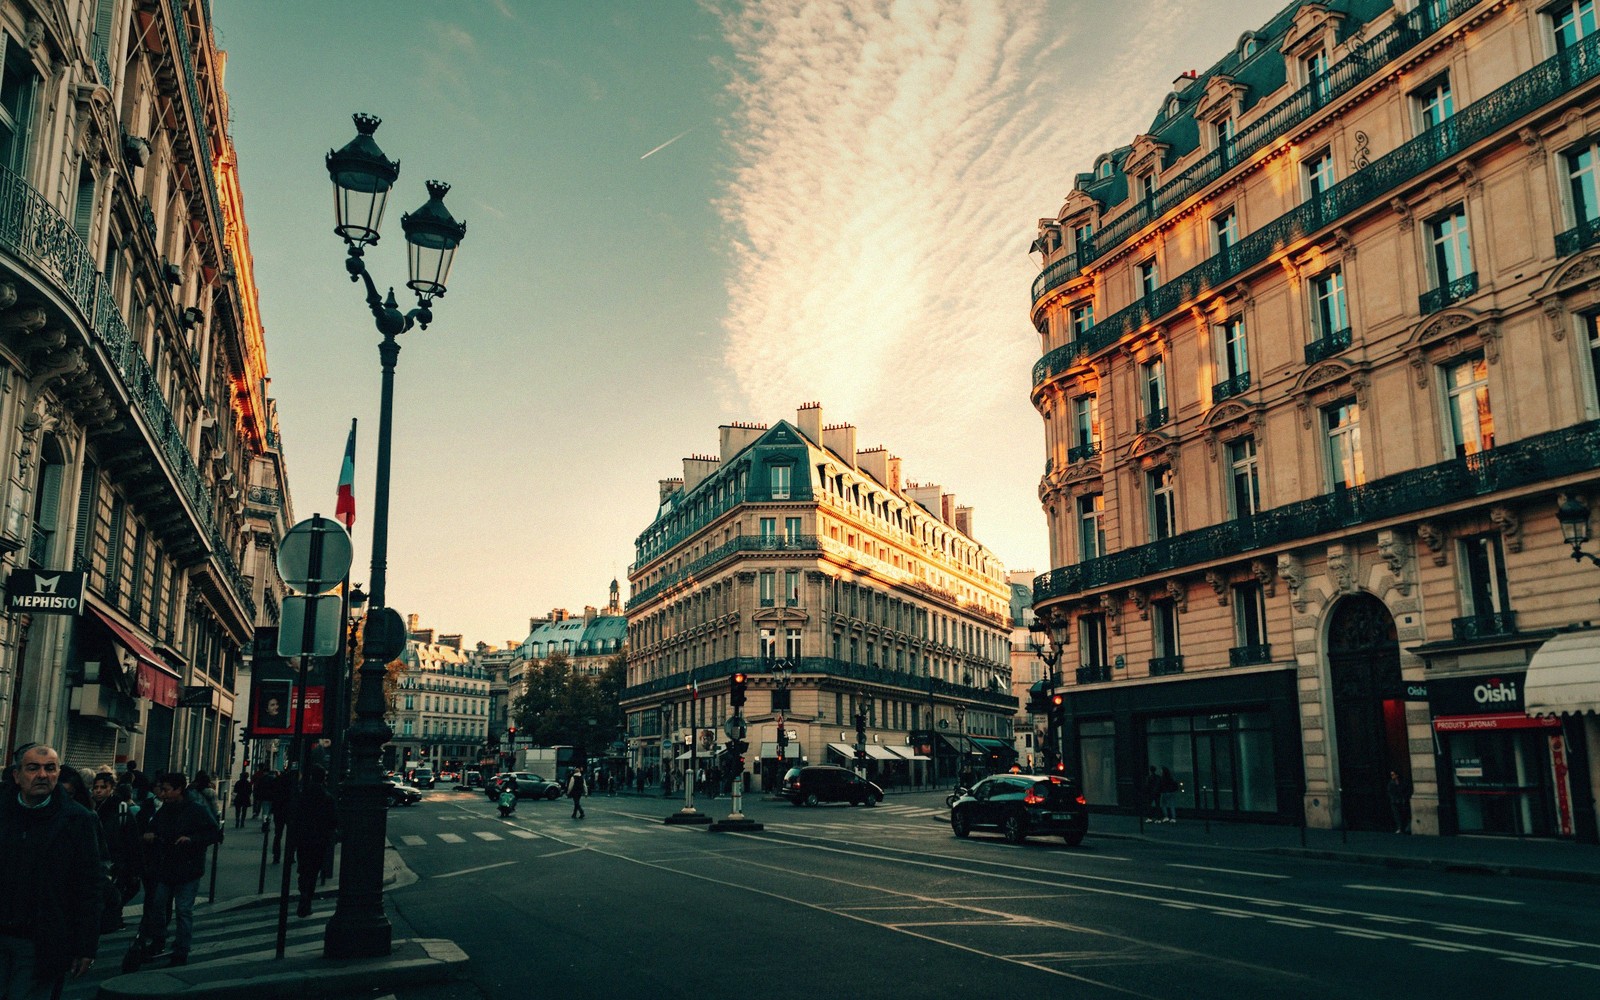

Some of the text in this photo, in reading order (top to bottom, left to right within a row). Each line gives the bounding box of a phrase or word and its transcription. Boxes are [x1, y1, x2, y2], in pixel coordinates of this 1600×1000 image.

[12, 595, 78, 609] MEPHISTO
[1407, 686, 1428, 696] Oishi
[1474, 682, 1517, 704] Oishi
[1437, 720, 1497, 729] PRODUITS JAPONAIS
